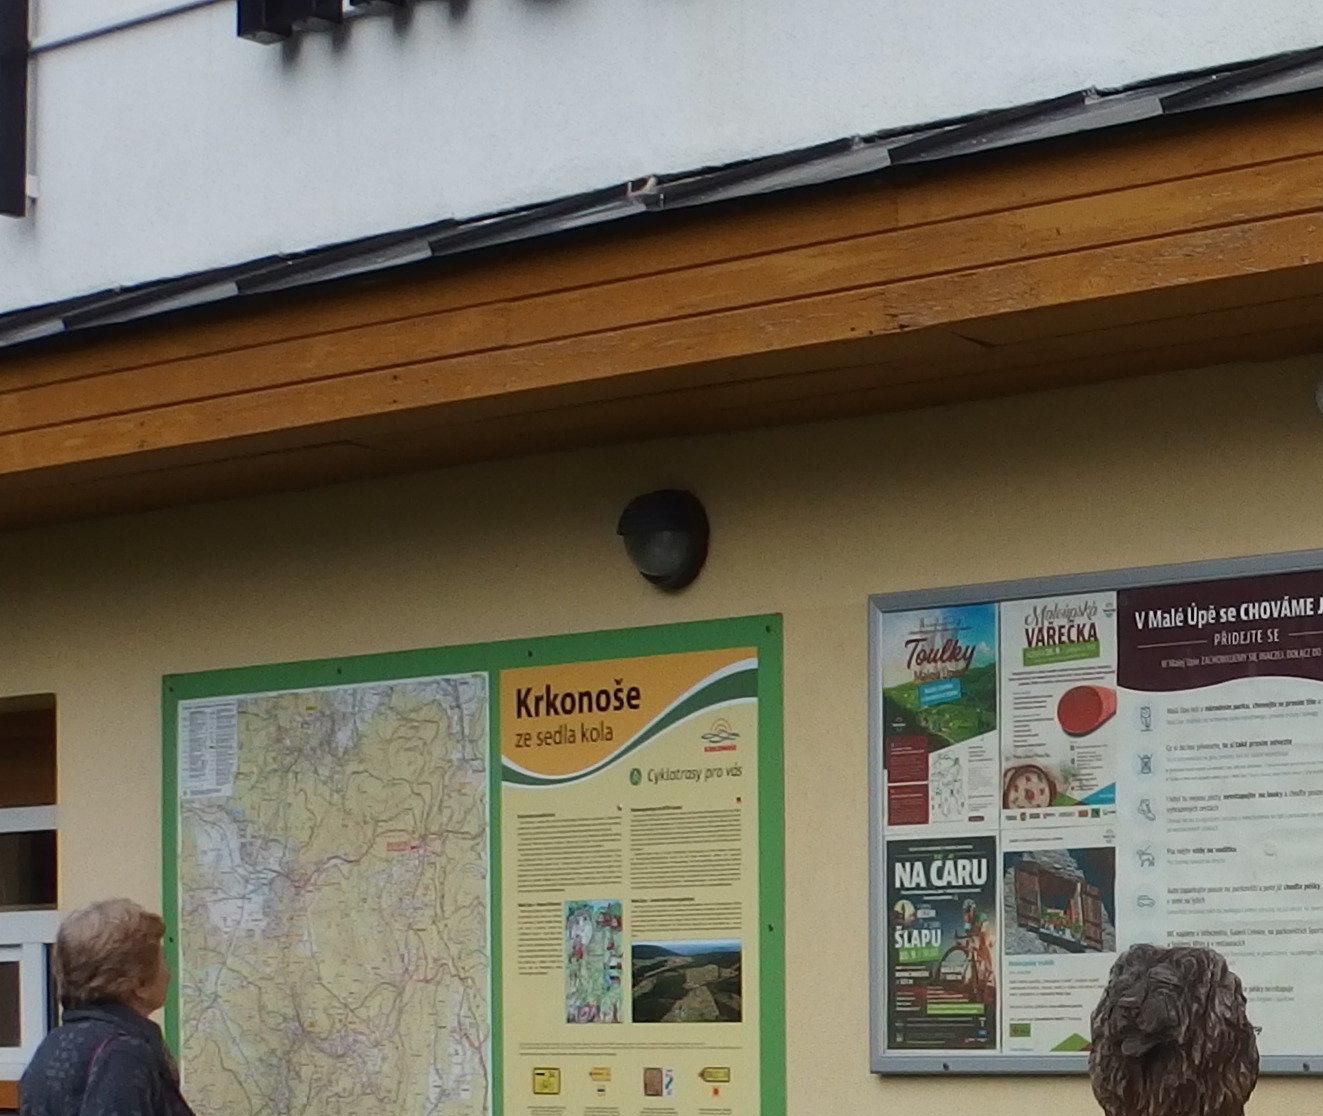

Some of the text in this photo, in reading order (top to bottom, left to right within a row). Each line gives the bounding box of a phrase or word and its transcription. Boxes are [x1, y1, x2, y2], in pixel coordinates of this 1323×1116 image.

[1135, 611, 1145, 629] V
[1149, 607, 1184, 628] Malé
[1188, 603, 1215, 628] Úpě
[1219, 608, 1236, 623] se
[1240, 596, 1314, 621] CHOVÁME
[1025, 620, 1098, 647] VAŘEČKA
[1214, 629, 1279, 646] PŘIDEJTE SE
[905, 637, 976, 672] Toulky
[516, 678, 641, 719] Krkonoše
[515, 721, 613, 748] ze sedla kola
[647, 762, 742, 785] Cyklotrasy pro vás
[895, 861, 926, 888] NA
[895, 925, 942, 948] ŠLAPU
